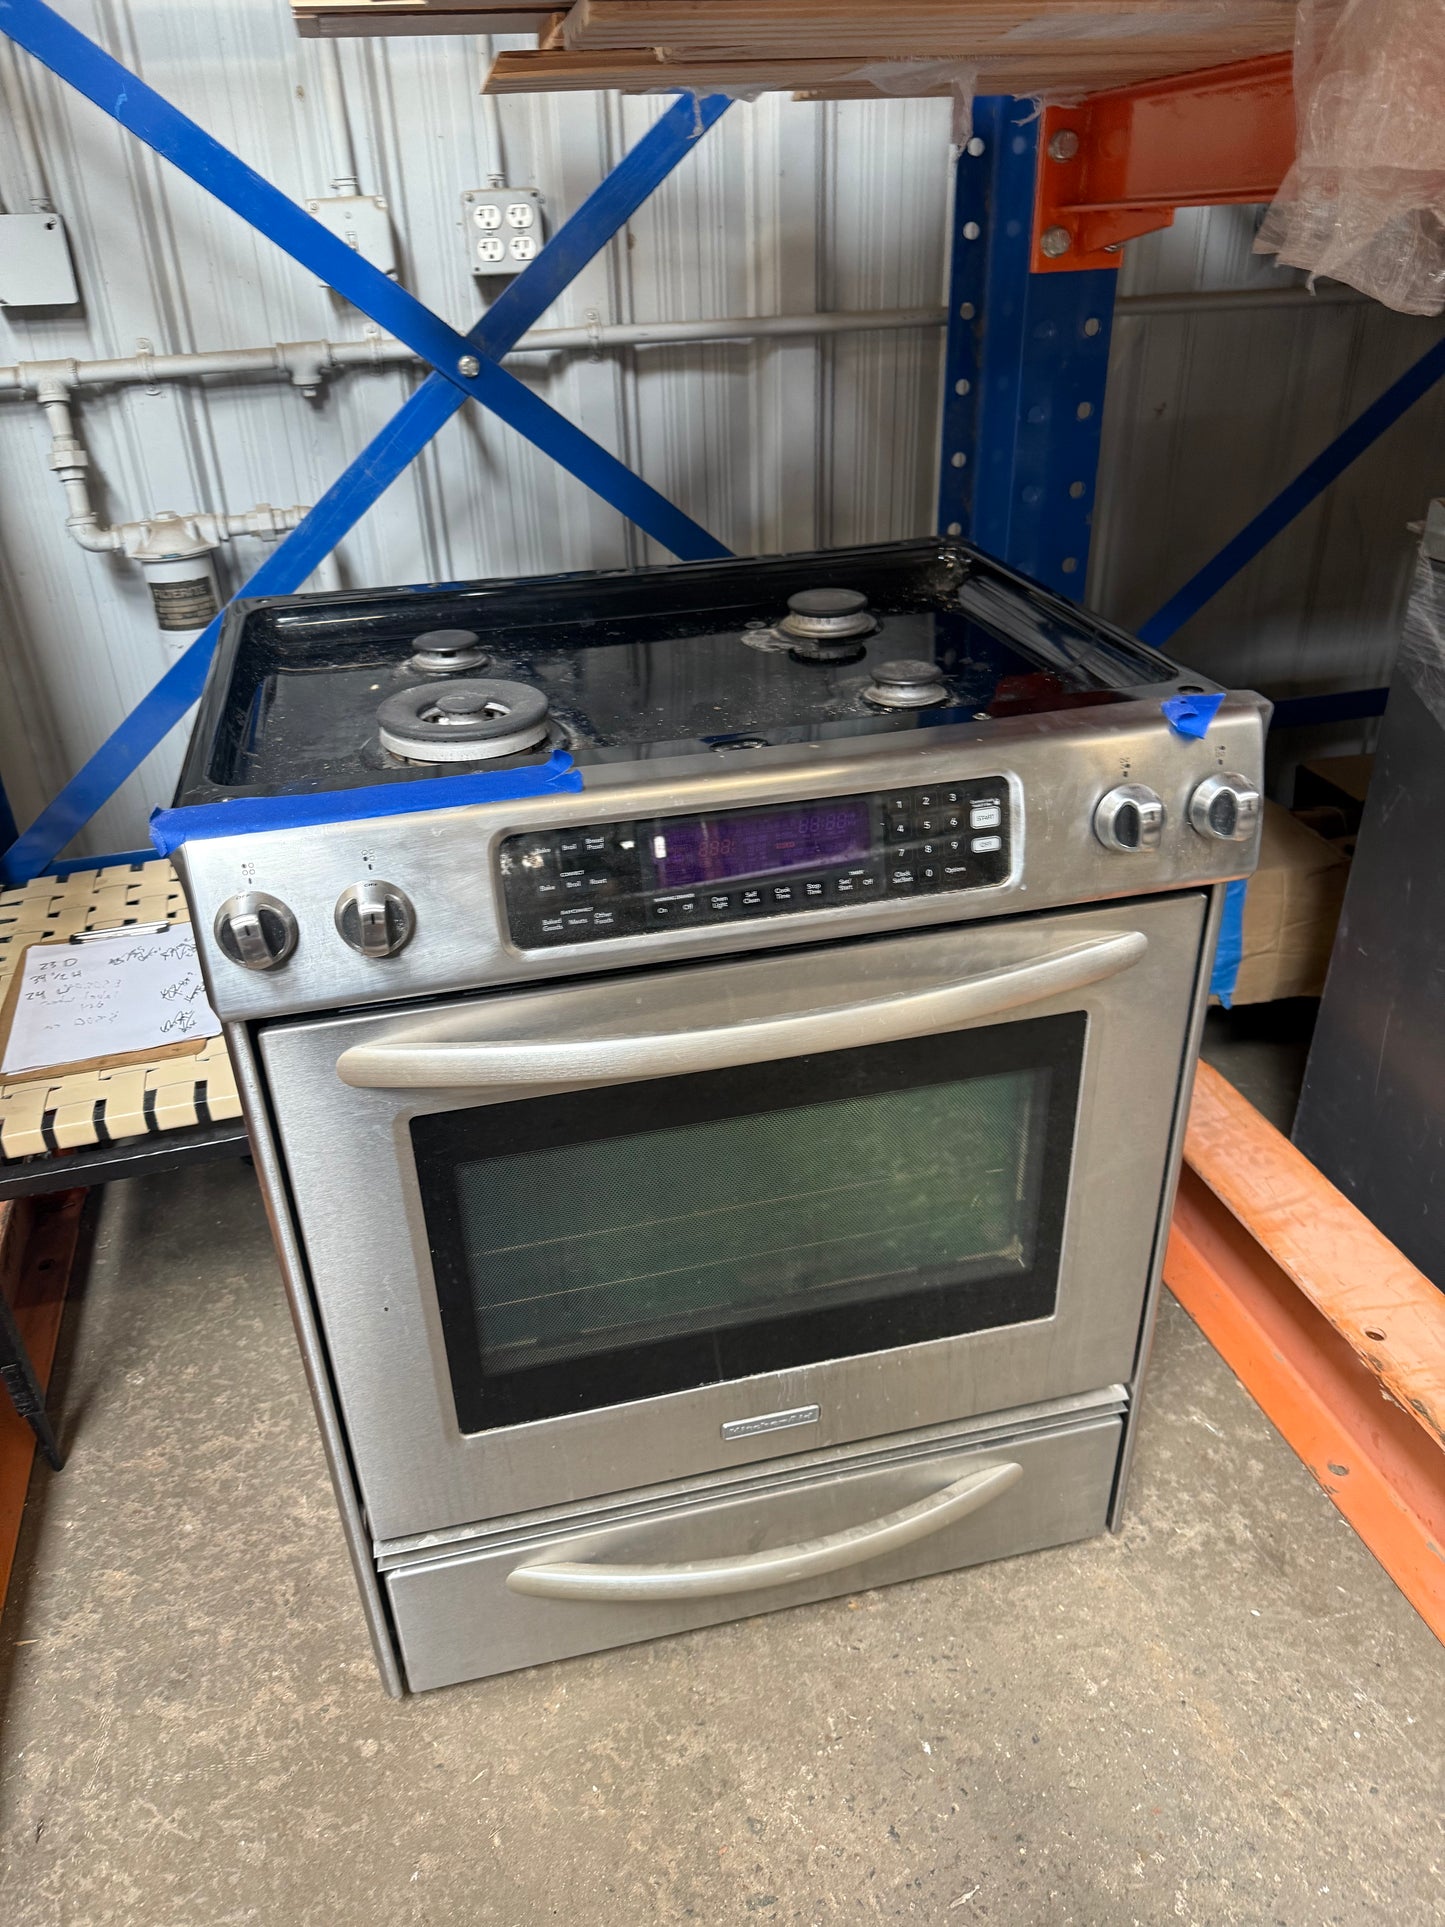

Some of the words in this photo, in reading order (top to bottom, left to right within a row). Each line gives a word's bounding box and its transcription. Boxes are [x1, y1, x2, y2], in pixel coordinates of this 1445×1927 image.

[922, 797, 930, 805] 2
[949, 793, 957, 801] 3
[896, 801, 903, 809] 1
[923, 821, 931, 829] 5
[898, 848, 905, 856] 7
[924, 845, 932, 853] 8
[925, 869, 933, 877] 0
